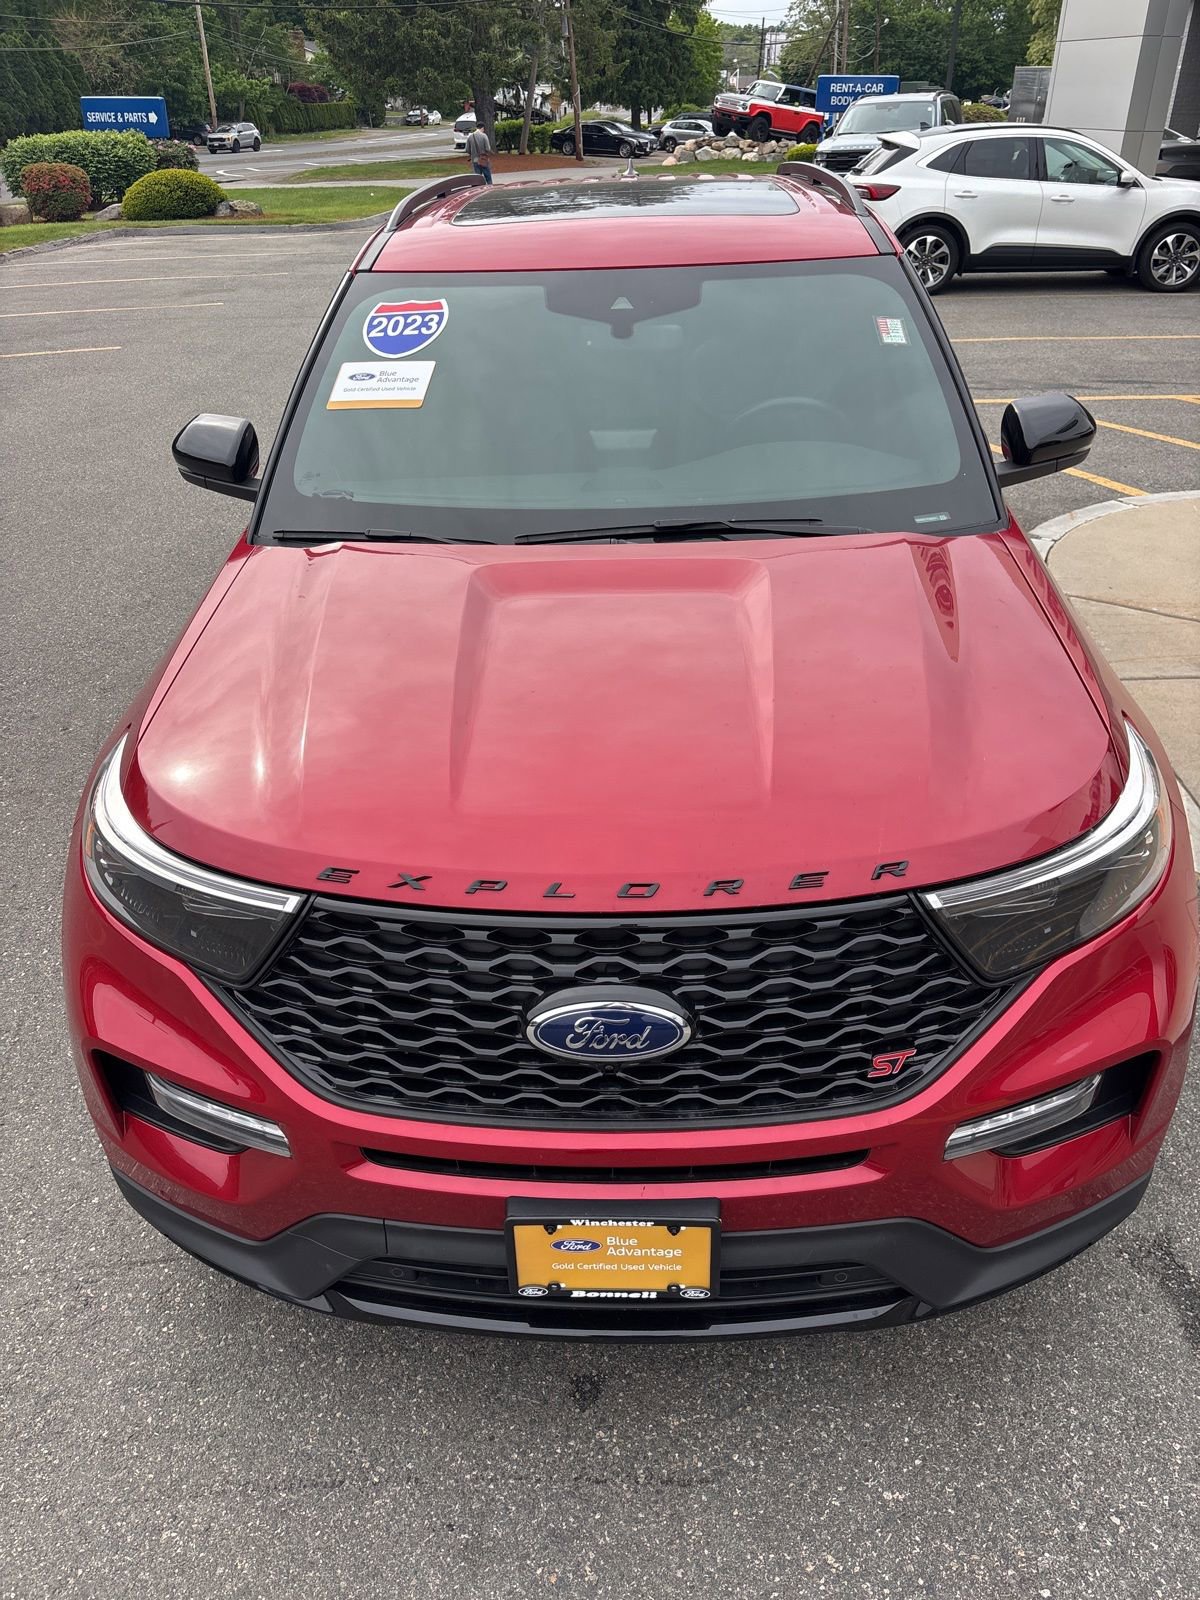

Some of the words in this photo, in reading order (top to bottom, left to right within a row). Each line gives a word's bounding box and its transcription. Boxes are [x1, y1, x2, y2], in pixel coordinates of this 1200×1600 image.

[830, 83, 884, 93] RENT-A-CAR
[86, 111, 116, 123] SERVICE
[117, 111, 123, 123] &
[124, 112, 148, 123] PARTS
[368, 313, 440, 338] 2023
[376, 376, 420, 384] Advantage
[316, 860, 909, 899] EXPLORER
[565, 1016, 653, 1050] Ford
[867, 1048, 917, 1078] ST
[570, 1219, 655, 1228] Winchester
[560, 1240, 593, 1251] Ford
[606, 1236, 638, 1246] Blue
[606, 1246, 682, 1258] Advantage
[551, 1262, 575, 1271] Gold
[577, 1262, 618, 1271] Certified
[620, 1262, 645, 1271] Used
[648, 1263, 682, 1271] Vehicle
[522, 1287, 544, 1296] Ford
[570, 1290, 658, 1299] Bonnell
[684, 1289, 706, 1298] Ford
